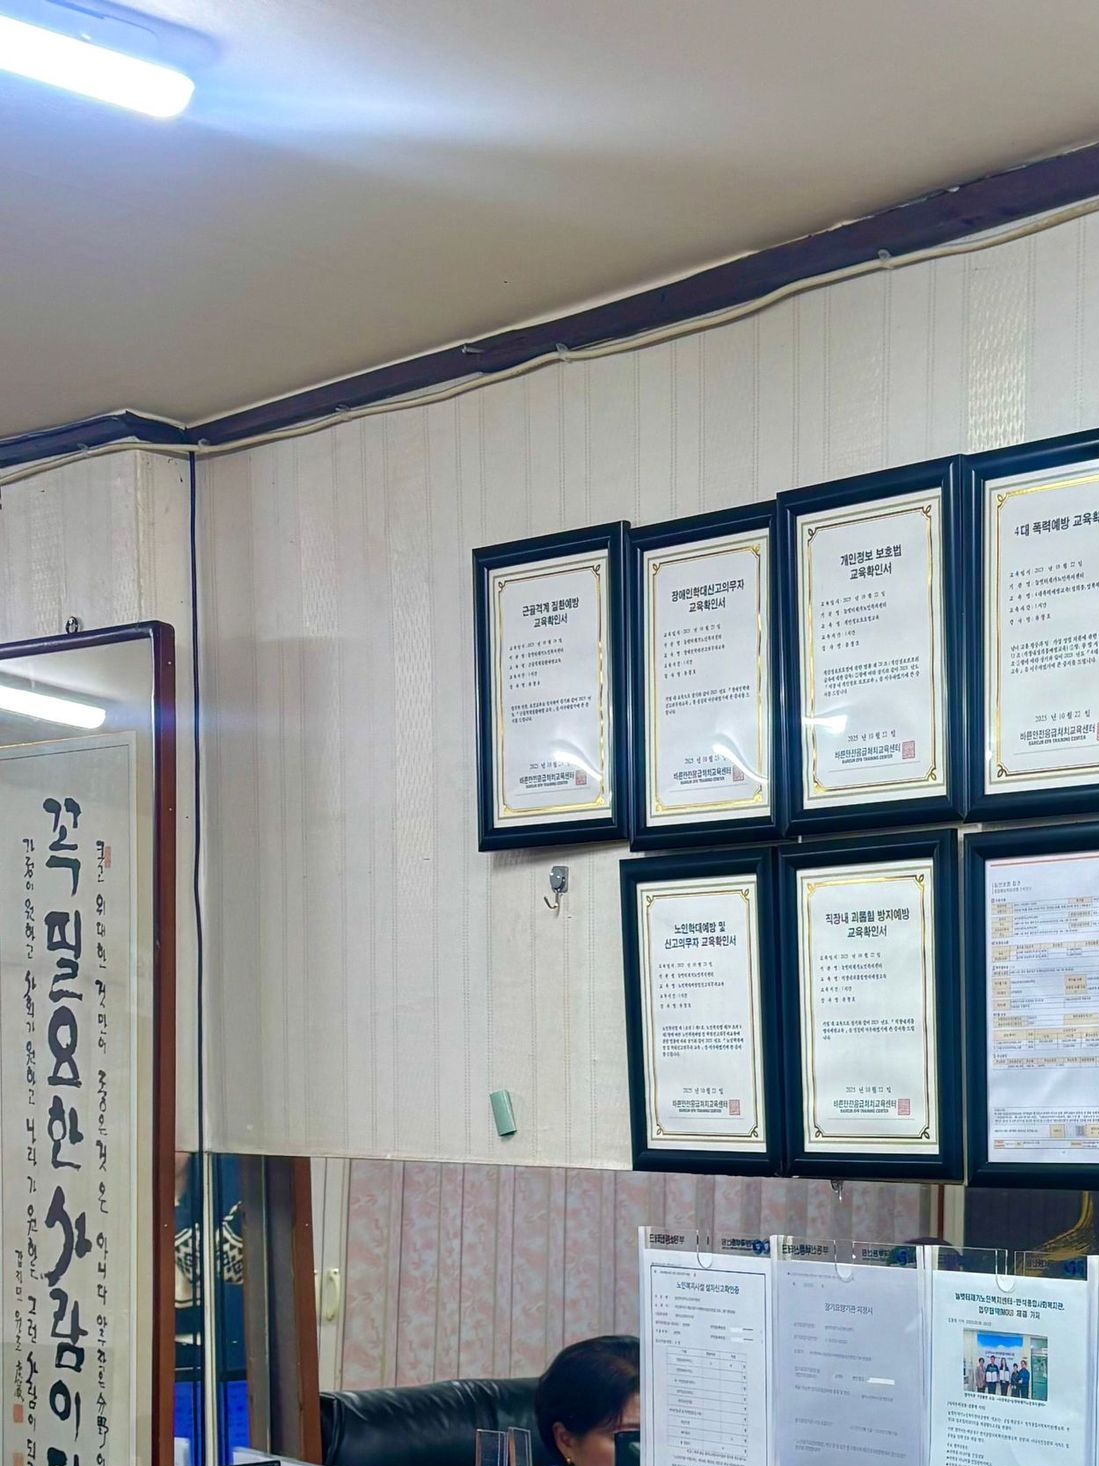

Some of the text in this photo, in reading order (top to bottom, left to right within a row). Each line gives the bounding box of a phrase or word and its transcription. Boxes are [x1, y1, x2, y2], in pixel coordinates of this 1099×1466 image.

[1032, 516, 1070, 535] 폭력예방
[840, 544, 902, 567] 개인정보 보호법
[849, 562, 892, 580] 교육확인서
[671, 579, 745, 602] 장애인학대신고의무자
[522, 600, 550, 617] 근골격계
[688, 597, 726, 613] 교육확인서
[533, 615, 568, 628] 교육확인서
[825, 911, 849, 926] 직장내
[674, 921, 717, 936] 노인학대예방
[847, 925, 887, 939] 교육확인서
[664, 934, 737, 950] 신고의무자 교육확인서
[41, 798, 93, 1441] 꼭 필요한 사람이
